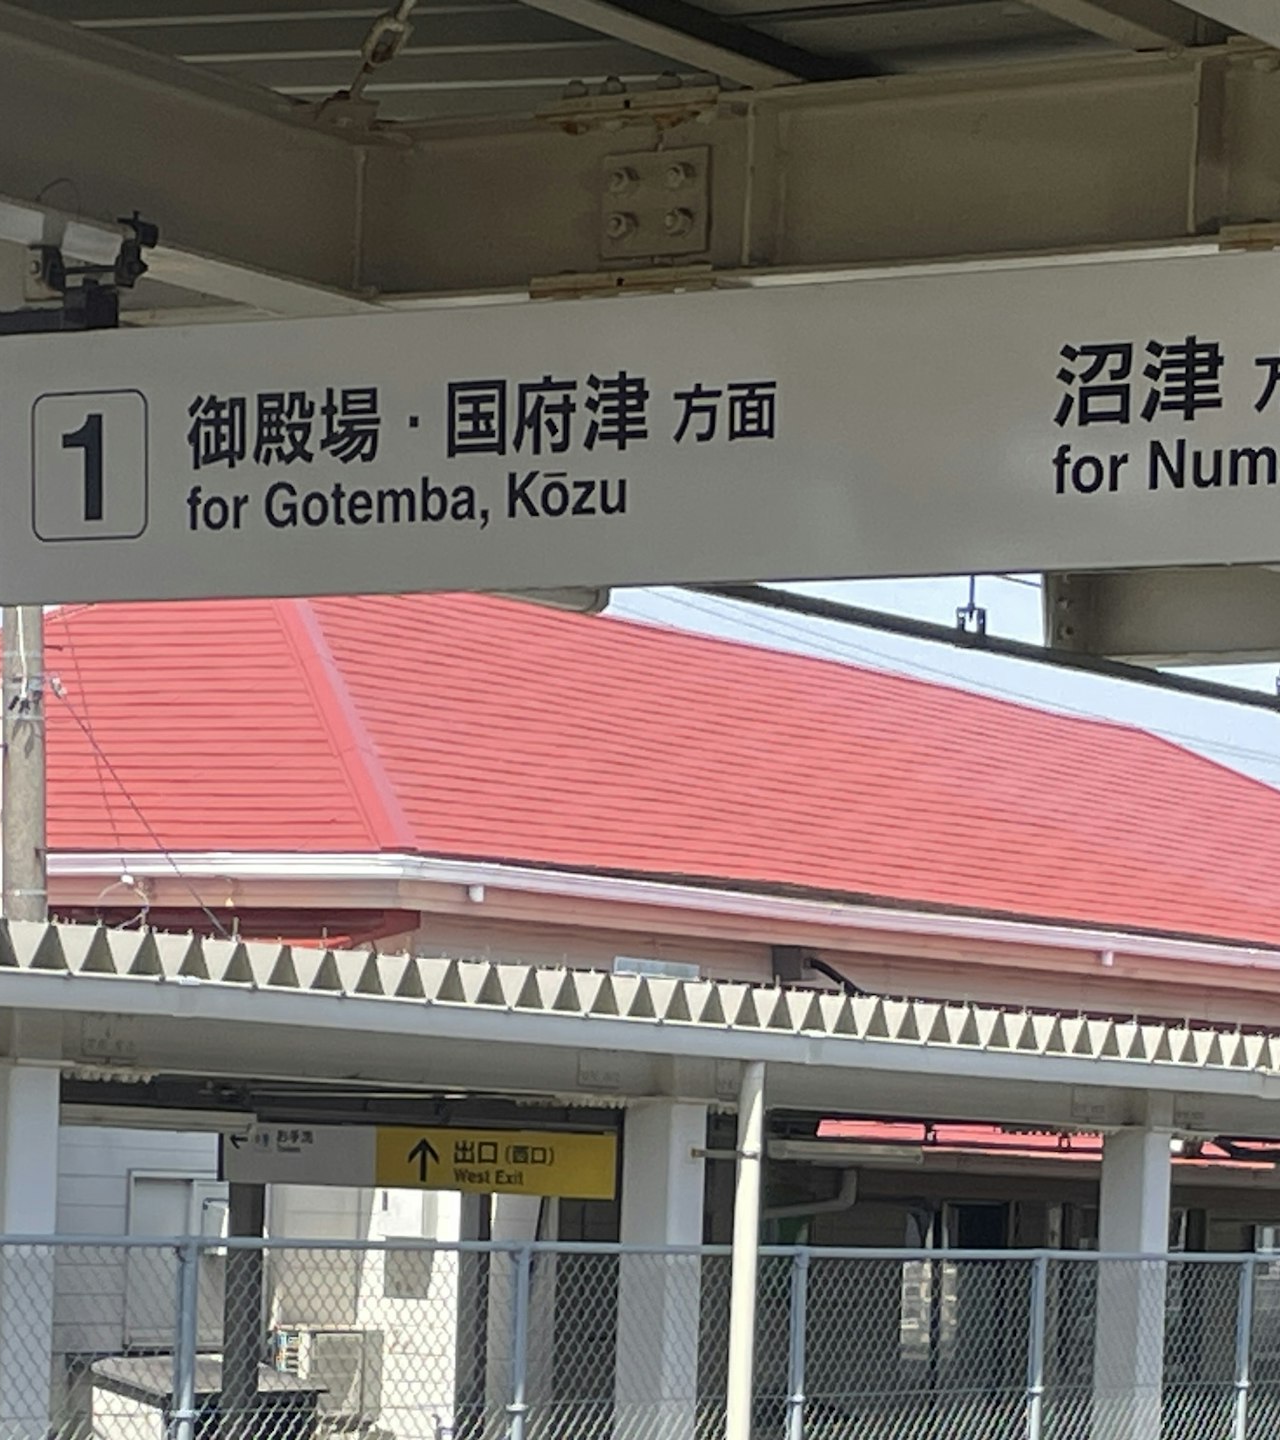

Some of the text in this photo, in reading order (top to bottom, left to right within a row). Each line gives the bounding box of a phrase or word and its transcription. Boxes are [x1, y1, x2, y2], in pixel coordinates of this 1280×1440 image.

[673, 381, 777, 443] 方面
[1053, 335, 1225, 428] 沼津
[62, 413, 103, 521] 1
[1052, 444, 1129, 494] for
[186, 470, 627, 531] for Gotemba, Kōzu
[453, 1168, 524, 1185] West Exit
